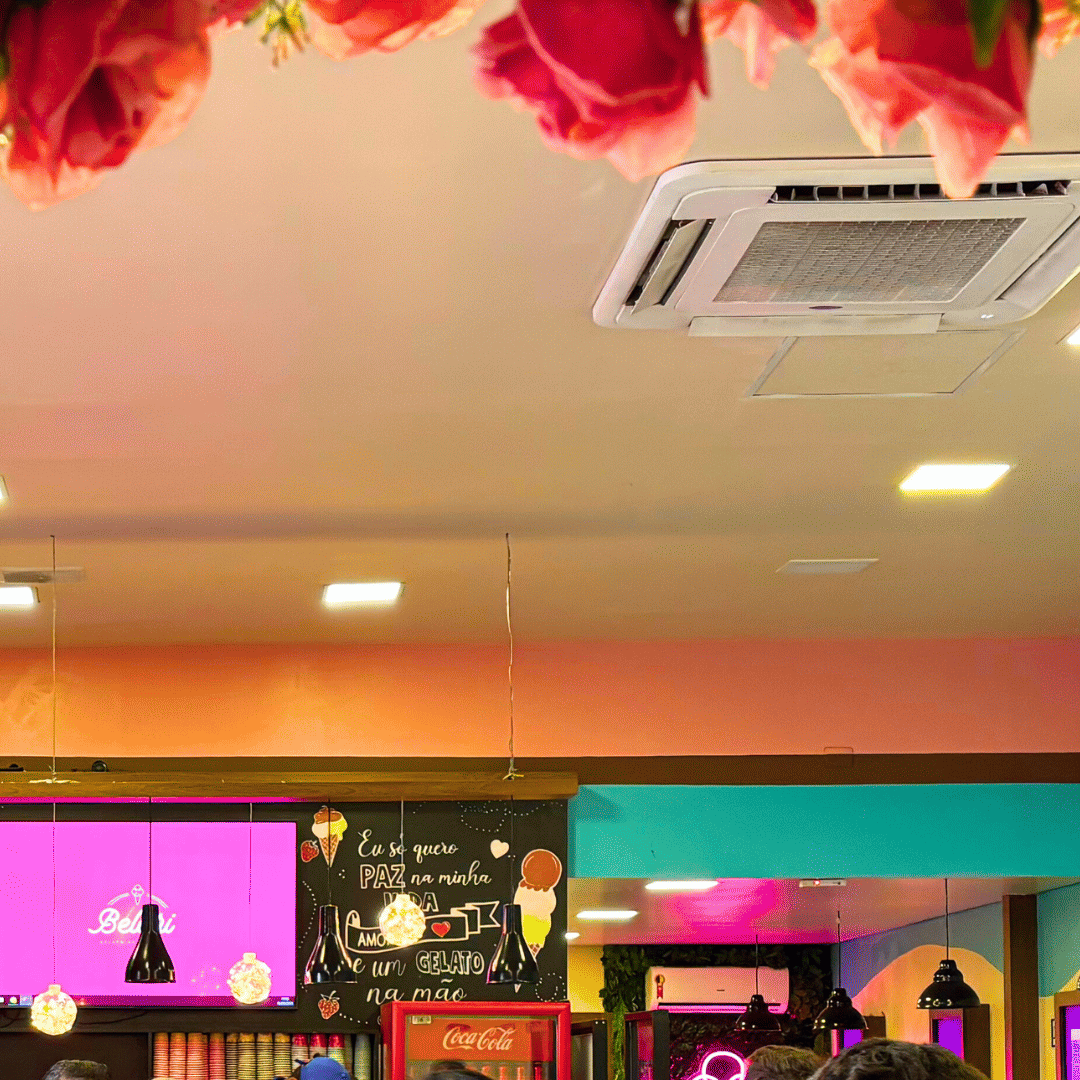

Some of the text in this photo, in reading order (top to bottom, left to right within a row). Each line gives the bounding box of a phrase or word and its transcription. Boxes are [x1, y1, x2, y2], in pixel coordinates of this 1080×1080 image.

[358, 828, 385, 857] Eu
[413, 841, 459, 864] quero
[360, 860, 493, 890] PAZ na minha
[352, 950, 485, 978] e um GELATO
[366, 978, 468, 1005] na mão
